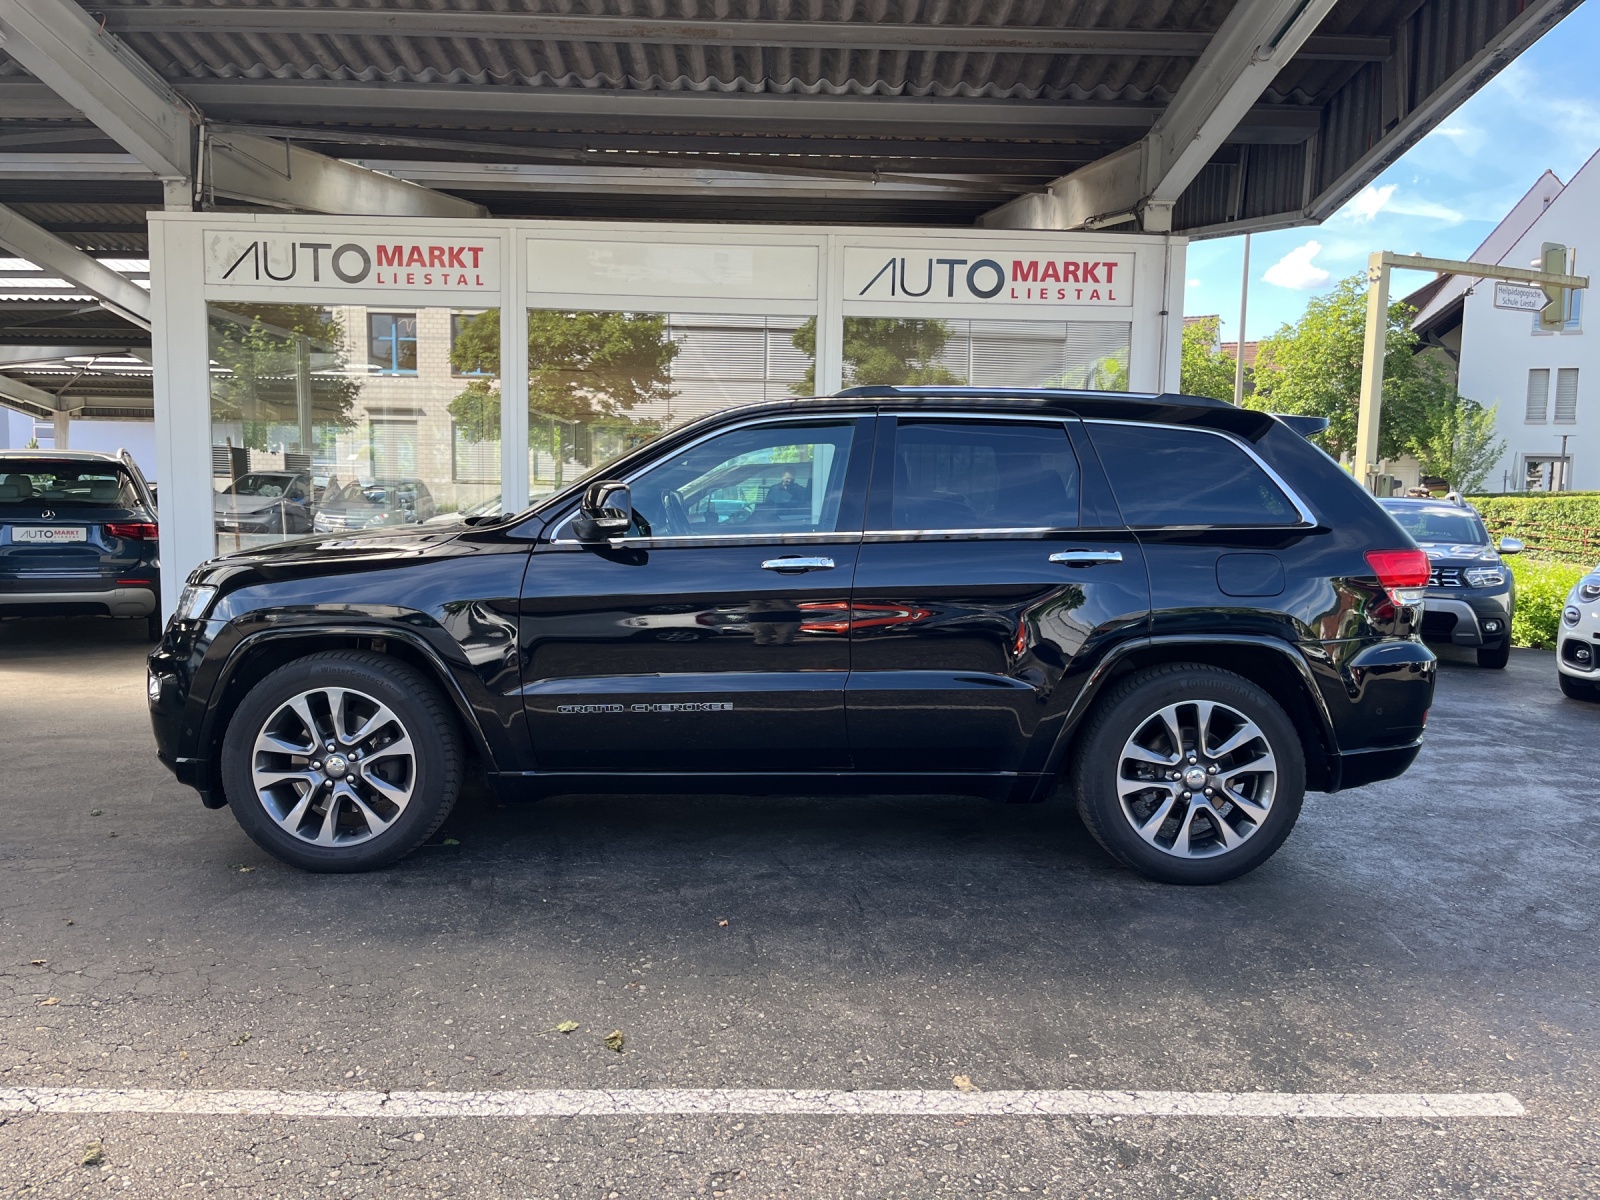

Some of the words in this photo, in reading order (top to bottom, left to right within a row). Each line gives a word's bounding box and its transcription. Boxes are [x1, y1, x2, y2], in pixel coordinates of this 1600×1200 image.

[222, 241, 371, 284] AUTO
[377, 245, 484, 268] MARKT
[377, 272, 484, 286] LIESTAL
[858, 257, 1005, 299] AUTO
[1012, 260, 1118, 283] MARKT
[1011, 287, 1116, 301] LIESTAL
[20, 530, 53, 538] AUTO
[557, 704, 624, 714] GRAND
[631, 702, 733, 712] CHEROKEE
